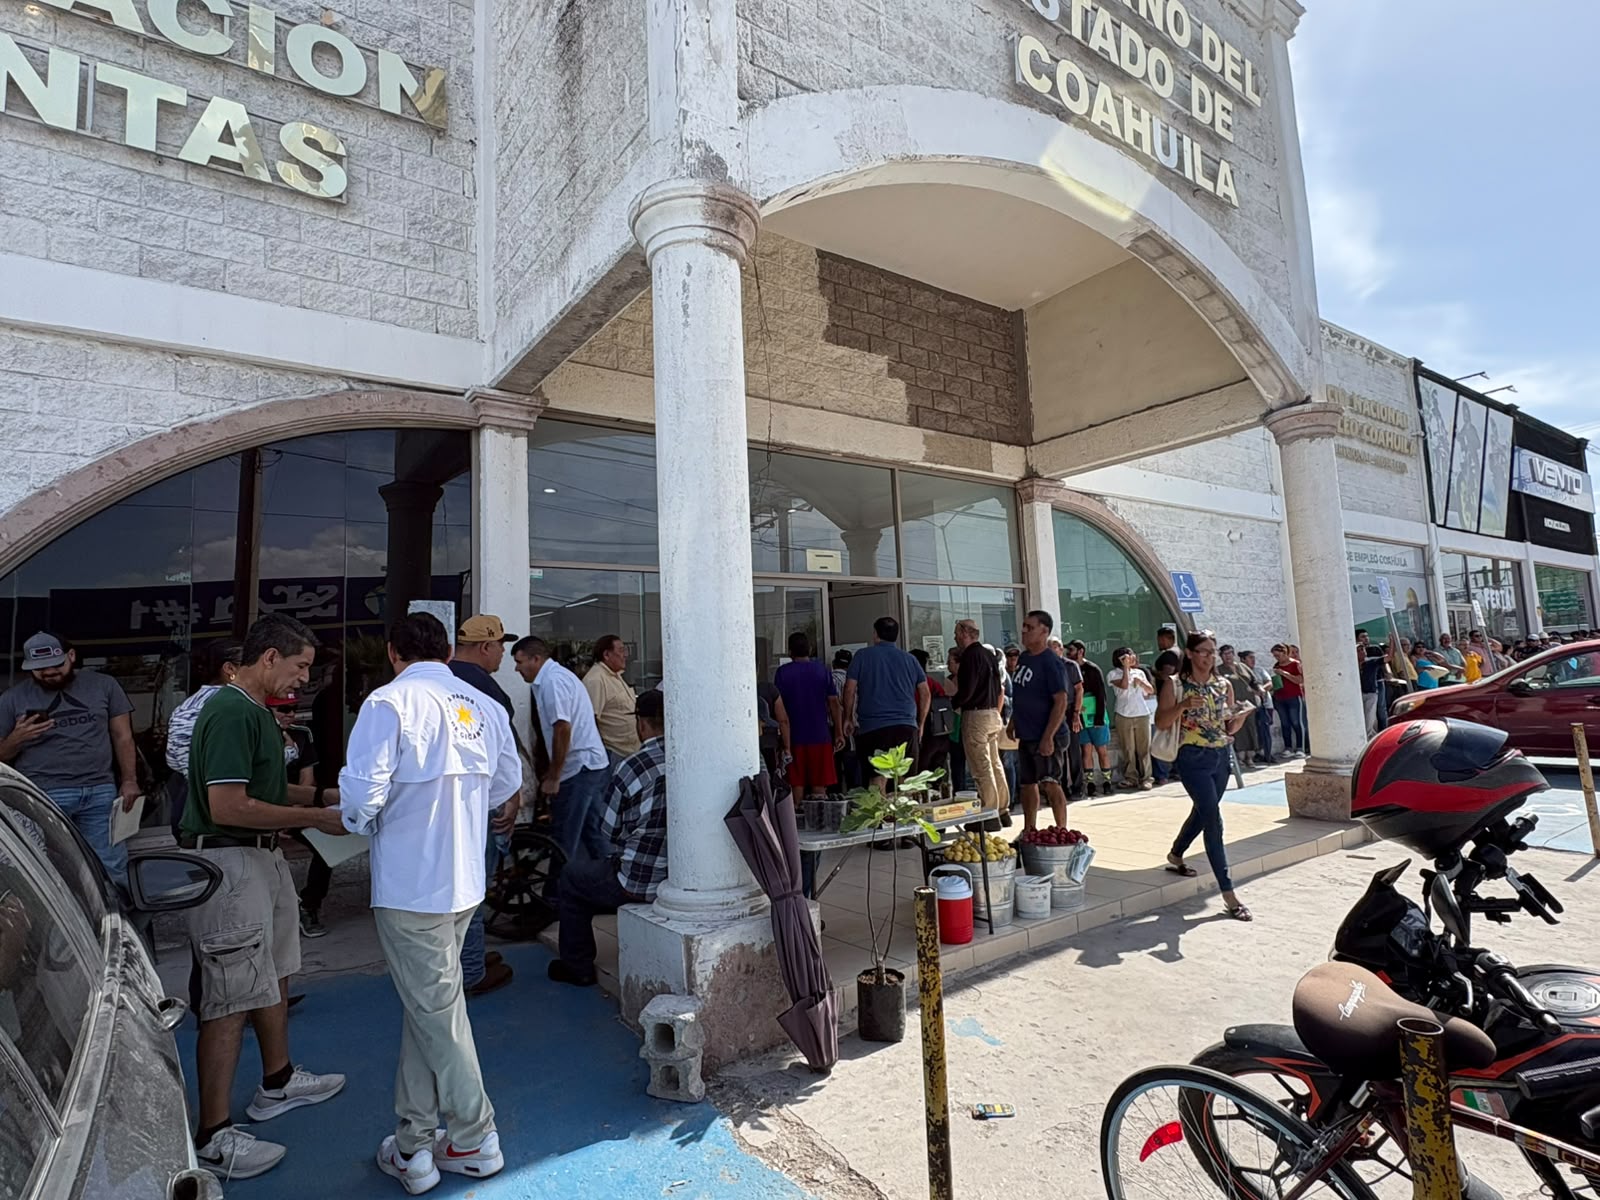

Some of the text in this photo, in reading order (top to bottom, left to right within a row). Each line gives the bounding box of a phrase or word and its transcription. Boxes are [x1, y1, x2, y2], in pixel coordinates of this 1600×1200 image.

[1202, 22, 1261, 107] DEL
[1018, 35, 1239, 208] COAHUILA
[1191, 73, 1234, 143] DE
[1363, 422, 1418, 457] COAHUILA
[1530, 456, 1583, 495] VENTO
